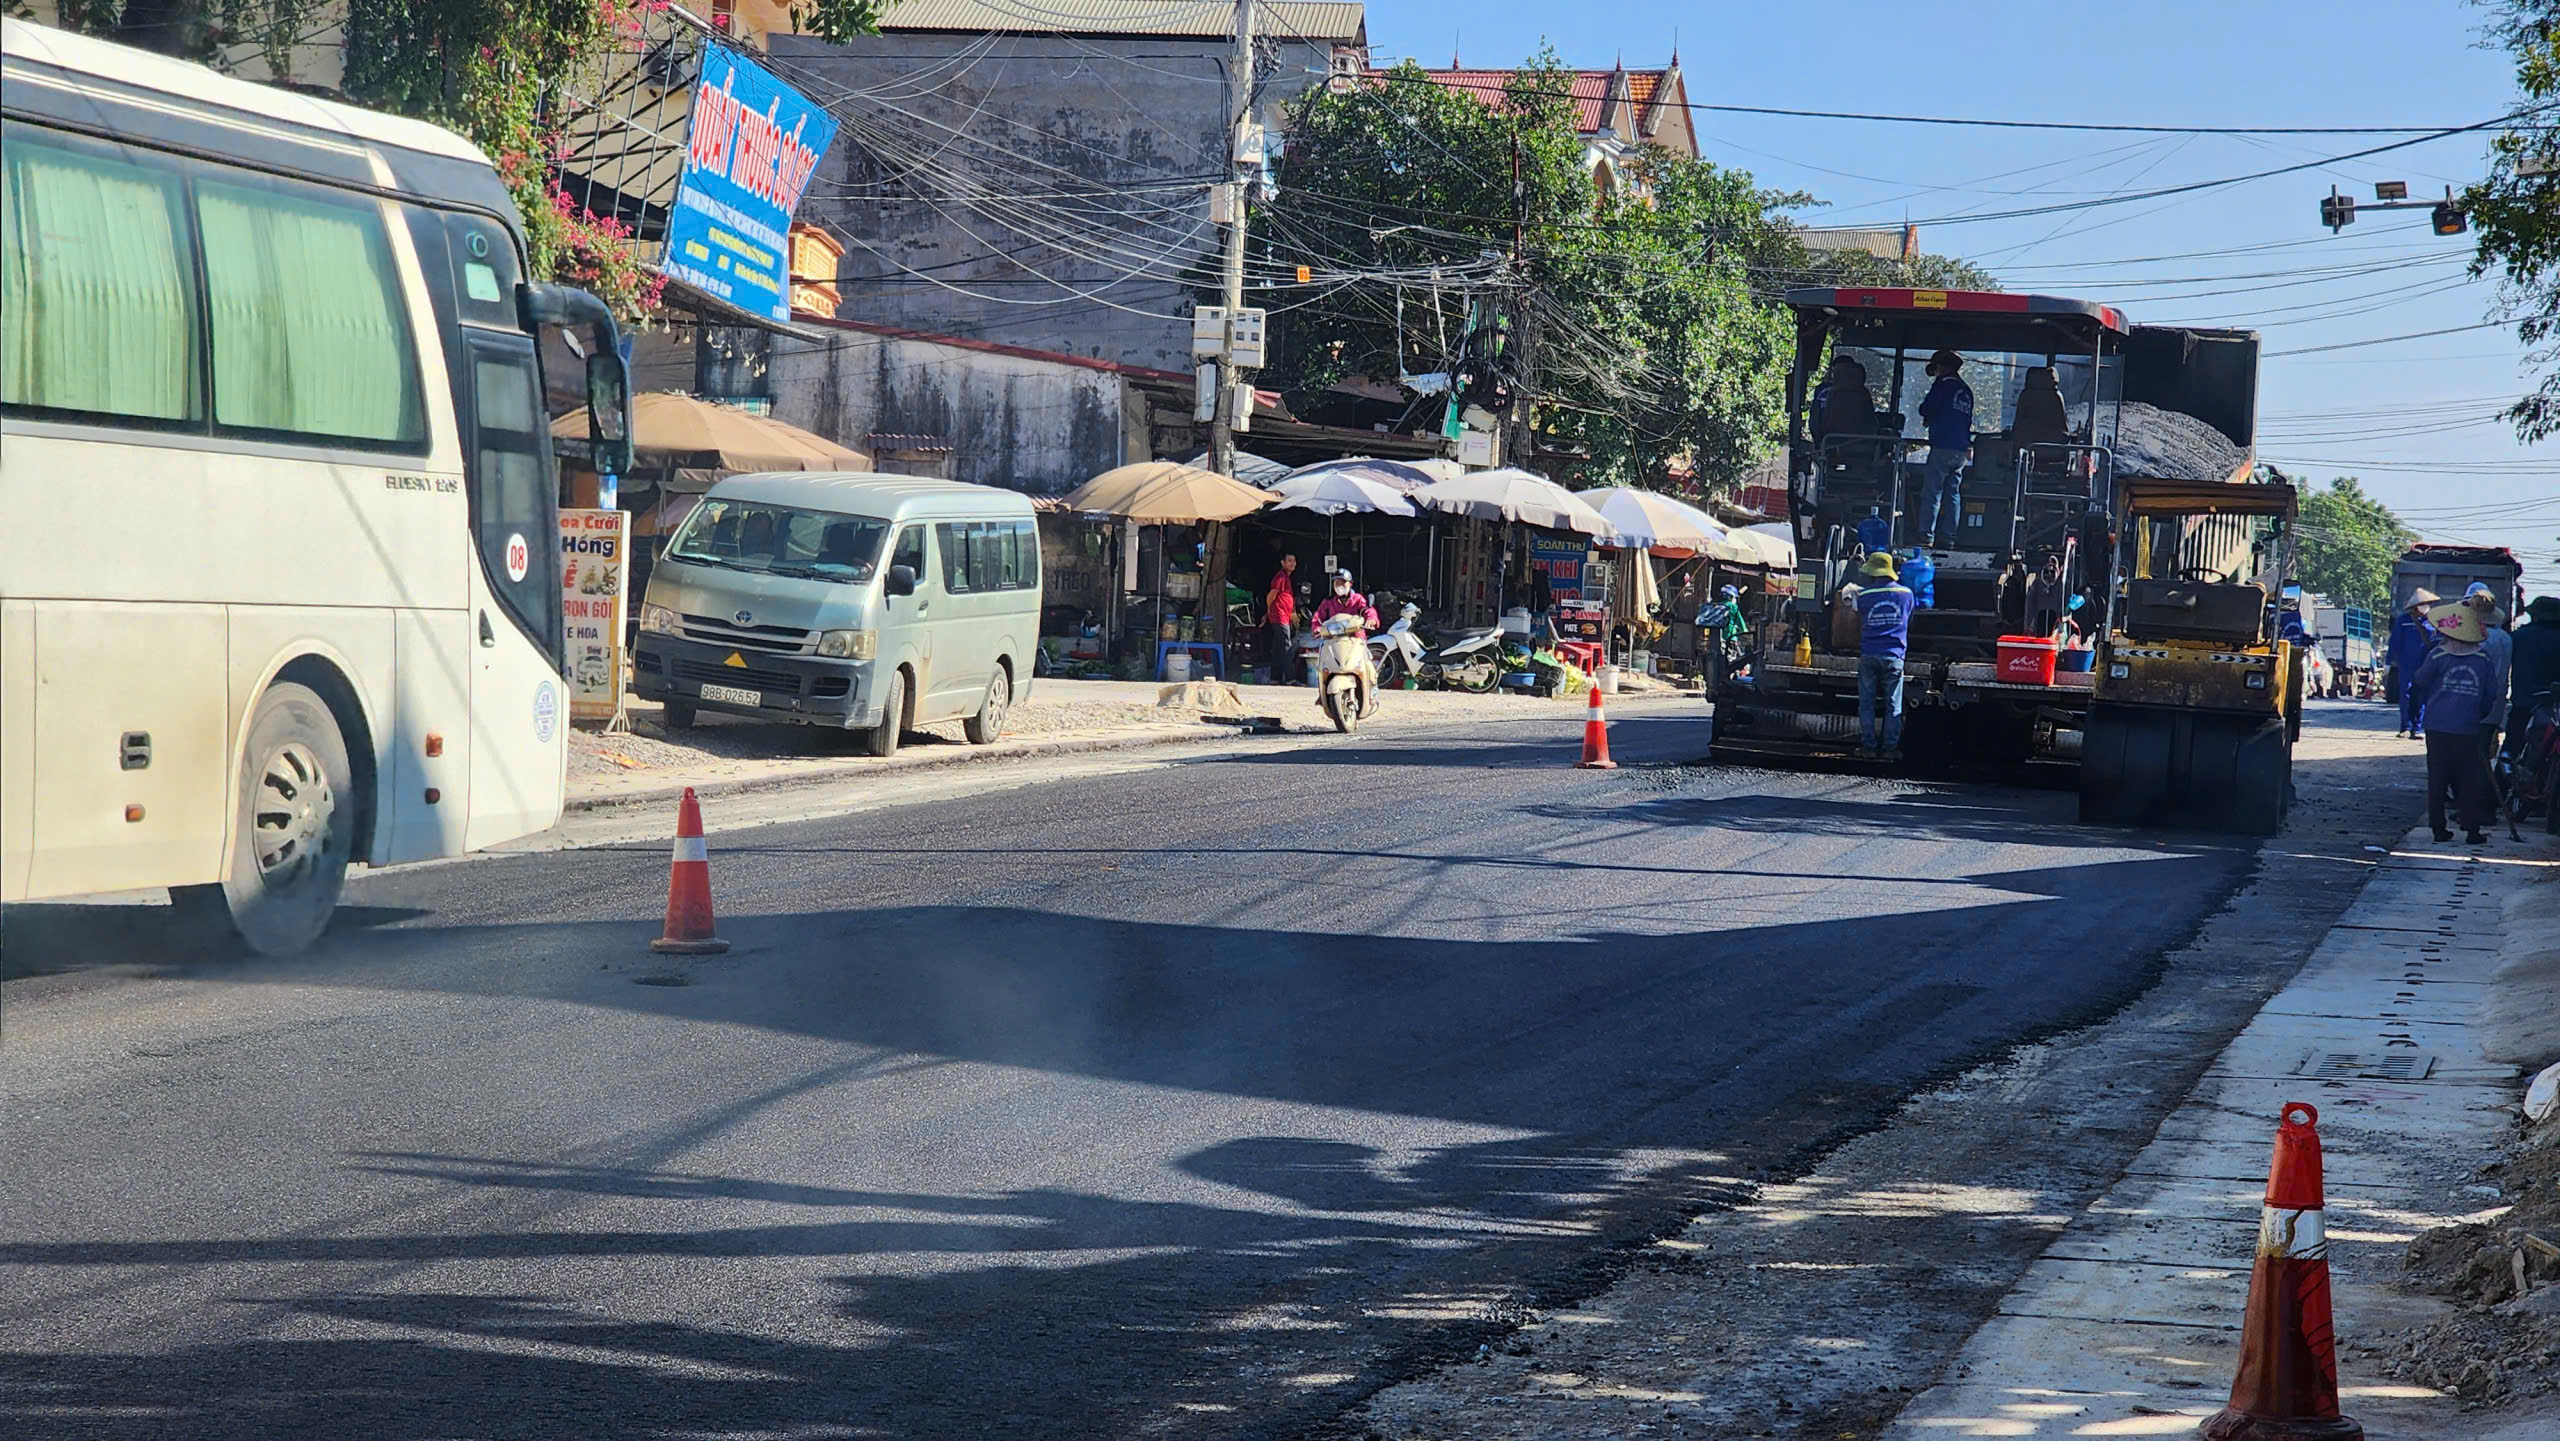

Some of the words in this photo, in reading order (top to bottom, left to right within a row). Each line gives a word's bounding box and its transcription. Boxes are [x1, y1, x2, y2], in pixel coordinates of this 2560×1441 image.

[730, 95, 782, 202] THUỐC
[560, 517, 579, 529] oa
[584, 515, 619, 530] Cưới
[510, 544, 525, 571] 08
[563, 600, 588, 621] RỌN
[592, 598, 612, 619] GÓI
[577, 627, 598, 639] HOA
[702, 686, 759, 705] 98B-026.52
